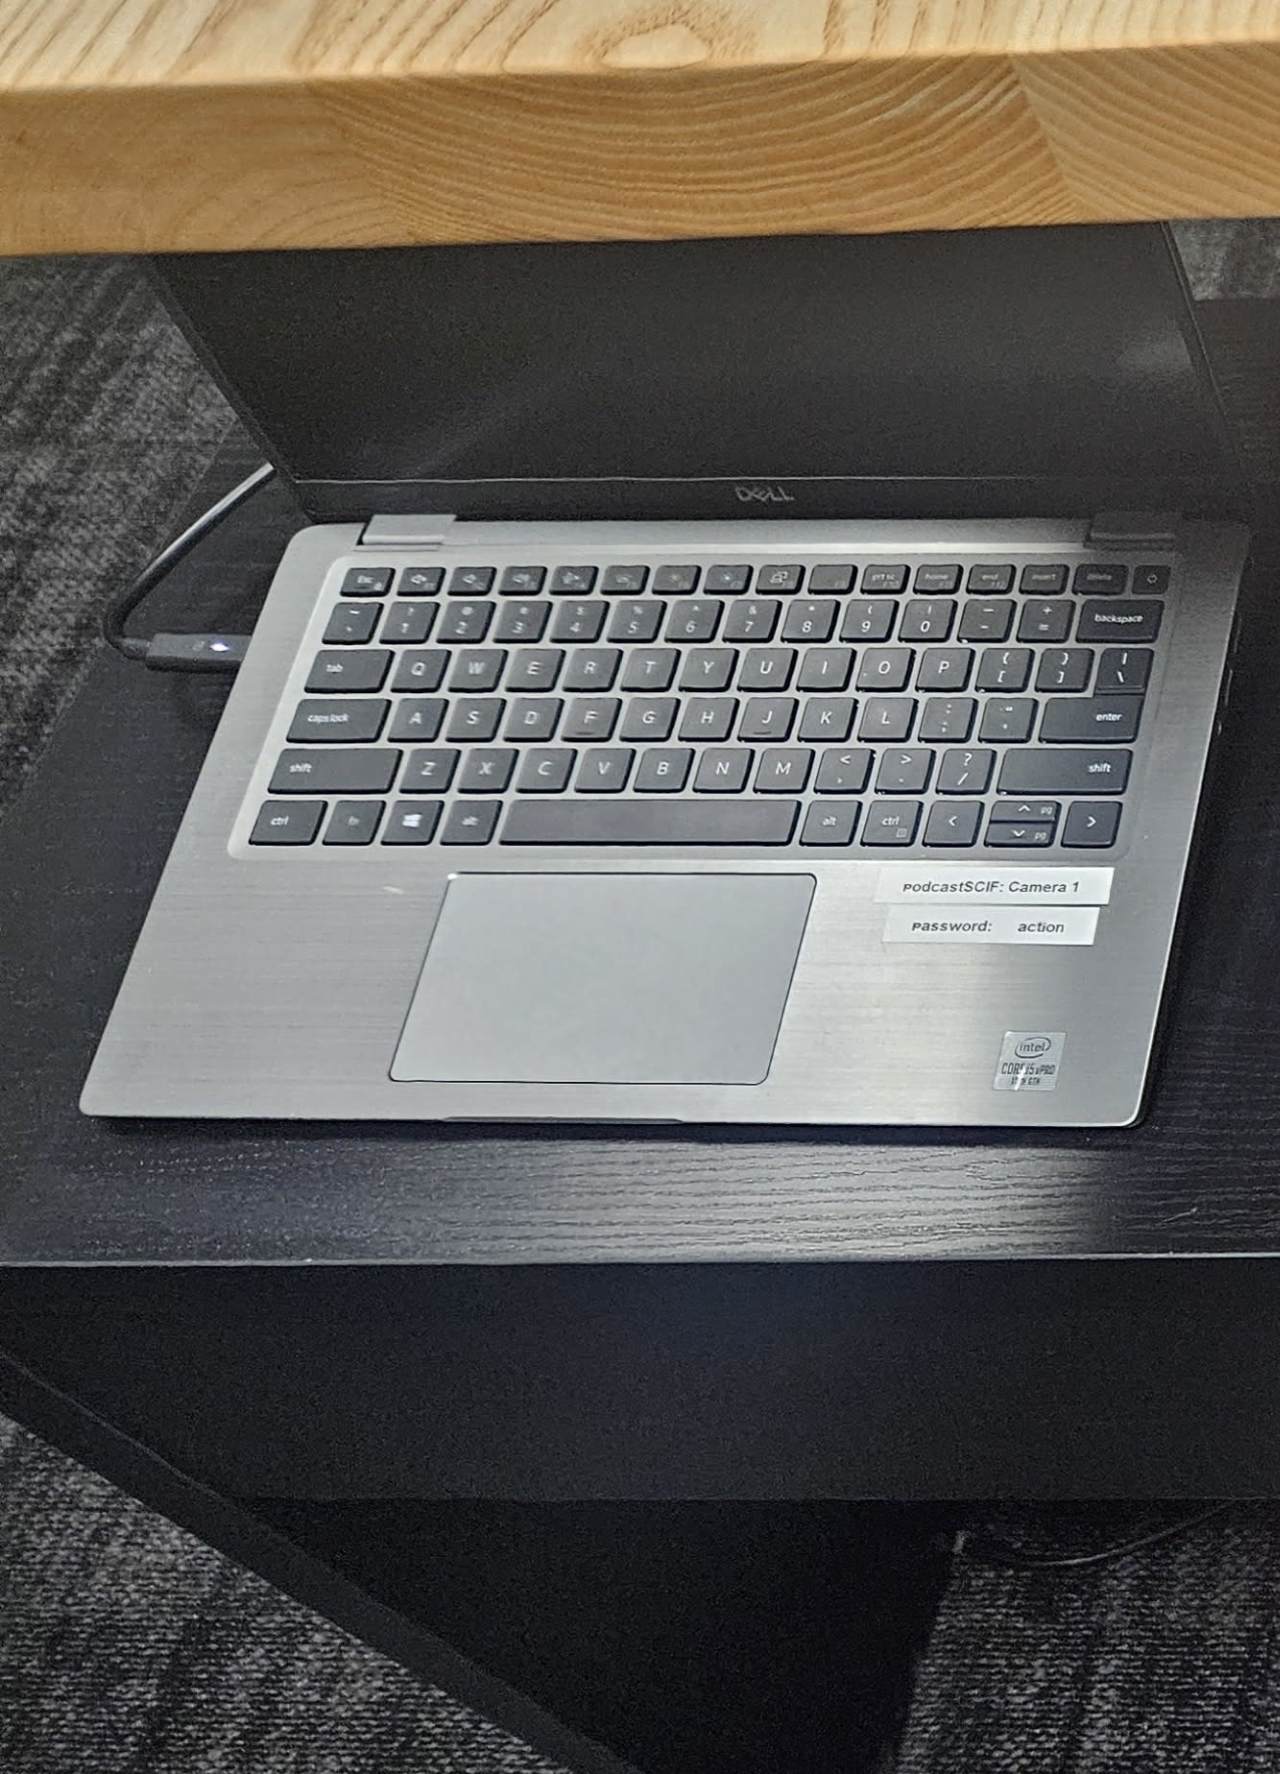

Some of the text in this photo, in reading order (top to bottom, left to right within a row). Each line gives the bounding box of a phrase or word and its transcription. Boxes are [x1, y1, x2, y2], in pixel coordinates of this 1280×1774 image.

[1094, 612, 1144, 626] backspace
[627, 621, 638, 634] 5
[685, 620, 696, 633] 6
[744, 620, 754, 633] 7
[802, 620, 813, 633] 8
[861, 620, 871, 633] 9
[920, 620, 931, 633] 0
[410, 662, 426, 676] Q
[468, 661, 485, 675] W
[526, 661, 541, 675] E
[583, 660, 597, 674] R
[645, 660, 657, 674] T
[703, 660, 715, 674] Y
[759, 660, 774, 675] U
[878, 660, 891, 674] O
[937, 660, 950, 674] P
[409, 712, 422, 724] A
[466, 710, 479, 725] S
[524, 710, 539, 725] D
[583, 710, 598, 724] F
[642, 710, 656, 724] G
[700, 711, 715, 724] H
[761, 710, 773, 724] J
[820, 711, 833, 724] K
[881, 711, 891, 725] L
[1095, 711, 1123, 723] enter
[421, 761, 436, 776] Z
[478, 761, 493, 775] X
[537, 761, 553, 776] C
[598, 761, 611, 775] V
[656, 761, 670, 775] B
[715, 761, 730, 775] N
[775, 761, 792, 775] M
[1088, 762, 1111, 774] shift
[823, 814, 837, 826] alt
[881, 814, 901, 827] ctrl
[1008, 880, 1067, 893] Camera
[1072, 881, 1080, 892] 1
[1017, 920, 1065, 933] action
